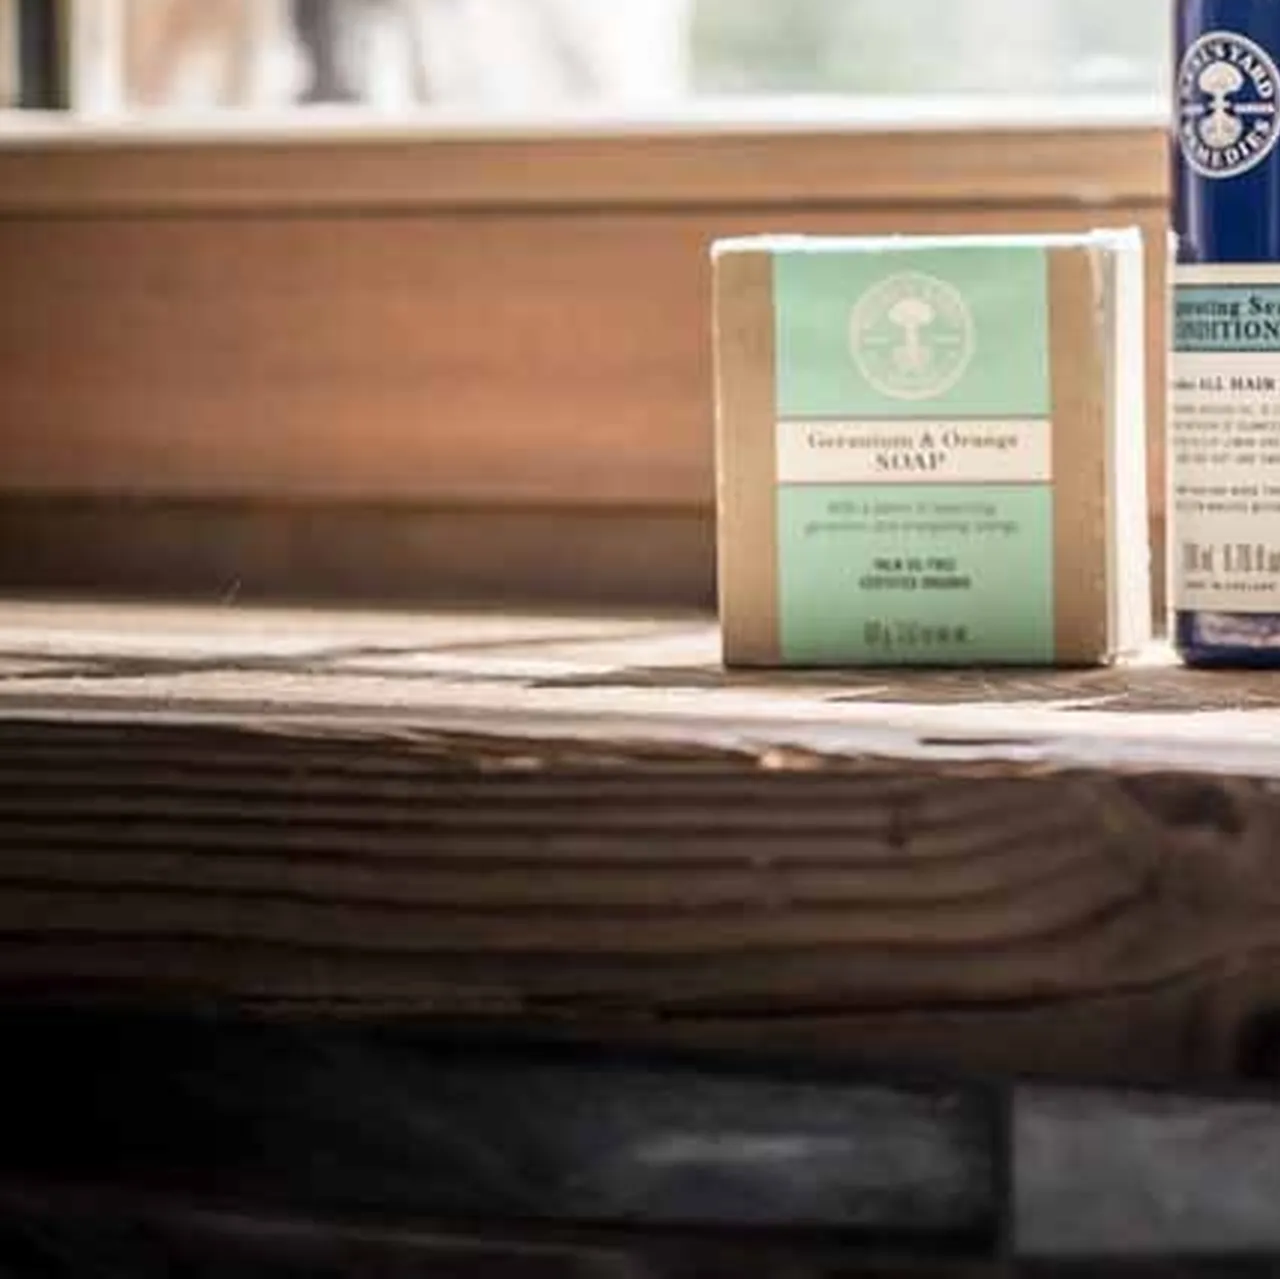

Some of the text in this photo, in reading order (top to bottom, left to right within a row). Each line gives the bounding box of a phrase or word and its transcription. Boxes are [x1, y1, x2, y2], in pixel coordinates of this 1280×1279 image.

[1229, 43, 1273, 99] YARD
[1230, 375, 1275, 391] HAIR
[942, 431, 1018, 450] Orange
[875, 452, 947, 471] SOAP
